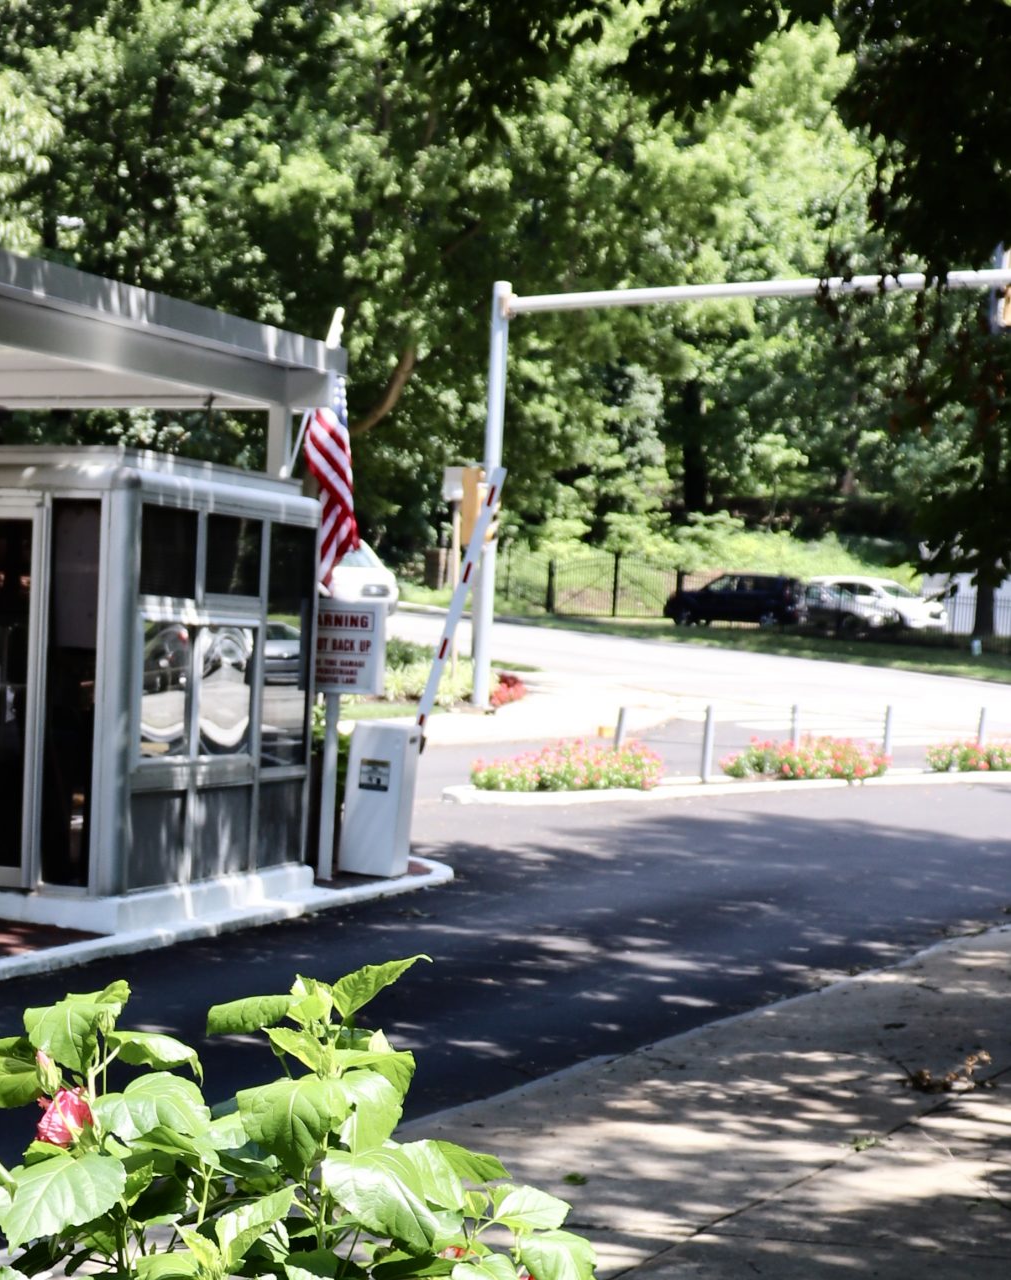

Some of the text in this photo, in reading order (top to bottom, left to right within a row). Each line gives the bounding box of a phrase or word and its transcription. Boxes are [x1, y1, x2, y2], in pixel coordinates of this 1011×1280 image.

[318, 613, 369, 628] ARNING
[332, 639, 355, 651] BACK
[359, 641, 372, 652] UP
